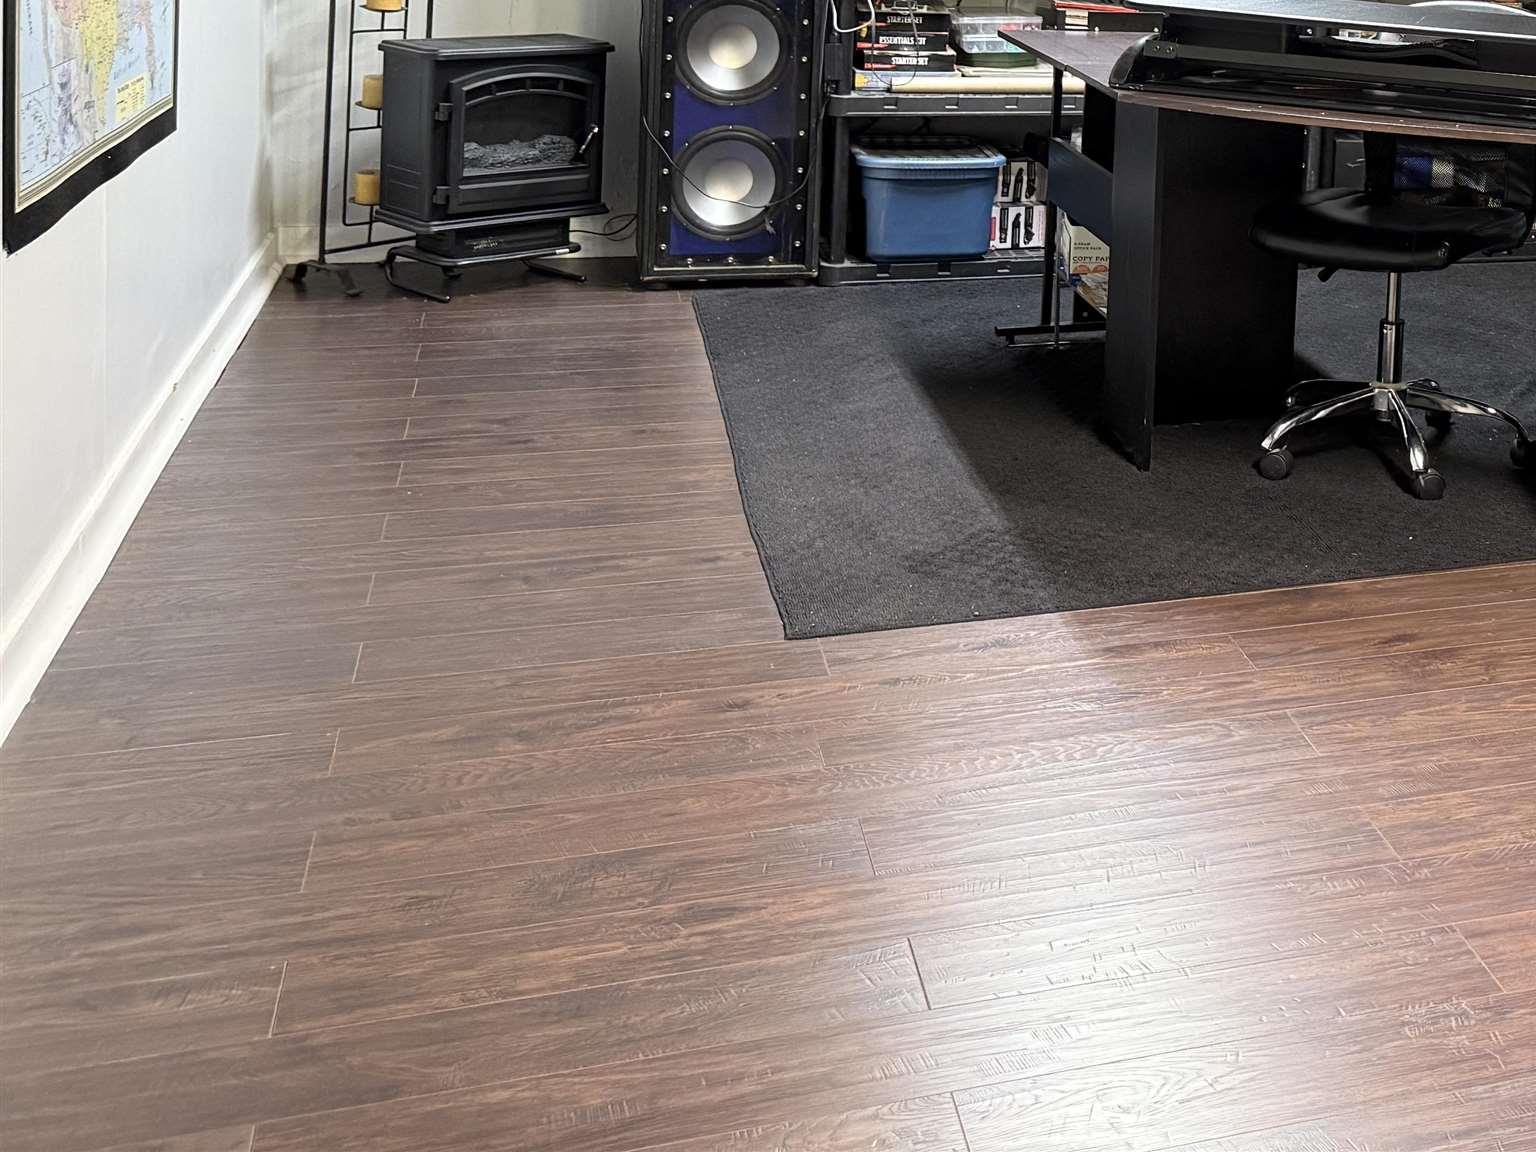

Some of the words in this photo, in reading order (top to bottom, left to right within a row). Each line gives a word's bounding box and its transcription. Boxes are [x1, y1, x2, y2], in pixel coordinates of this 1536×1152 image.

[886, 15, 912, 24] STARTER
[879, 36, 914, 45] ESSENTIALS
[891, 57, 917, 65] STARTER
[918, 57, 928, 65] SET
